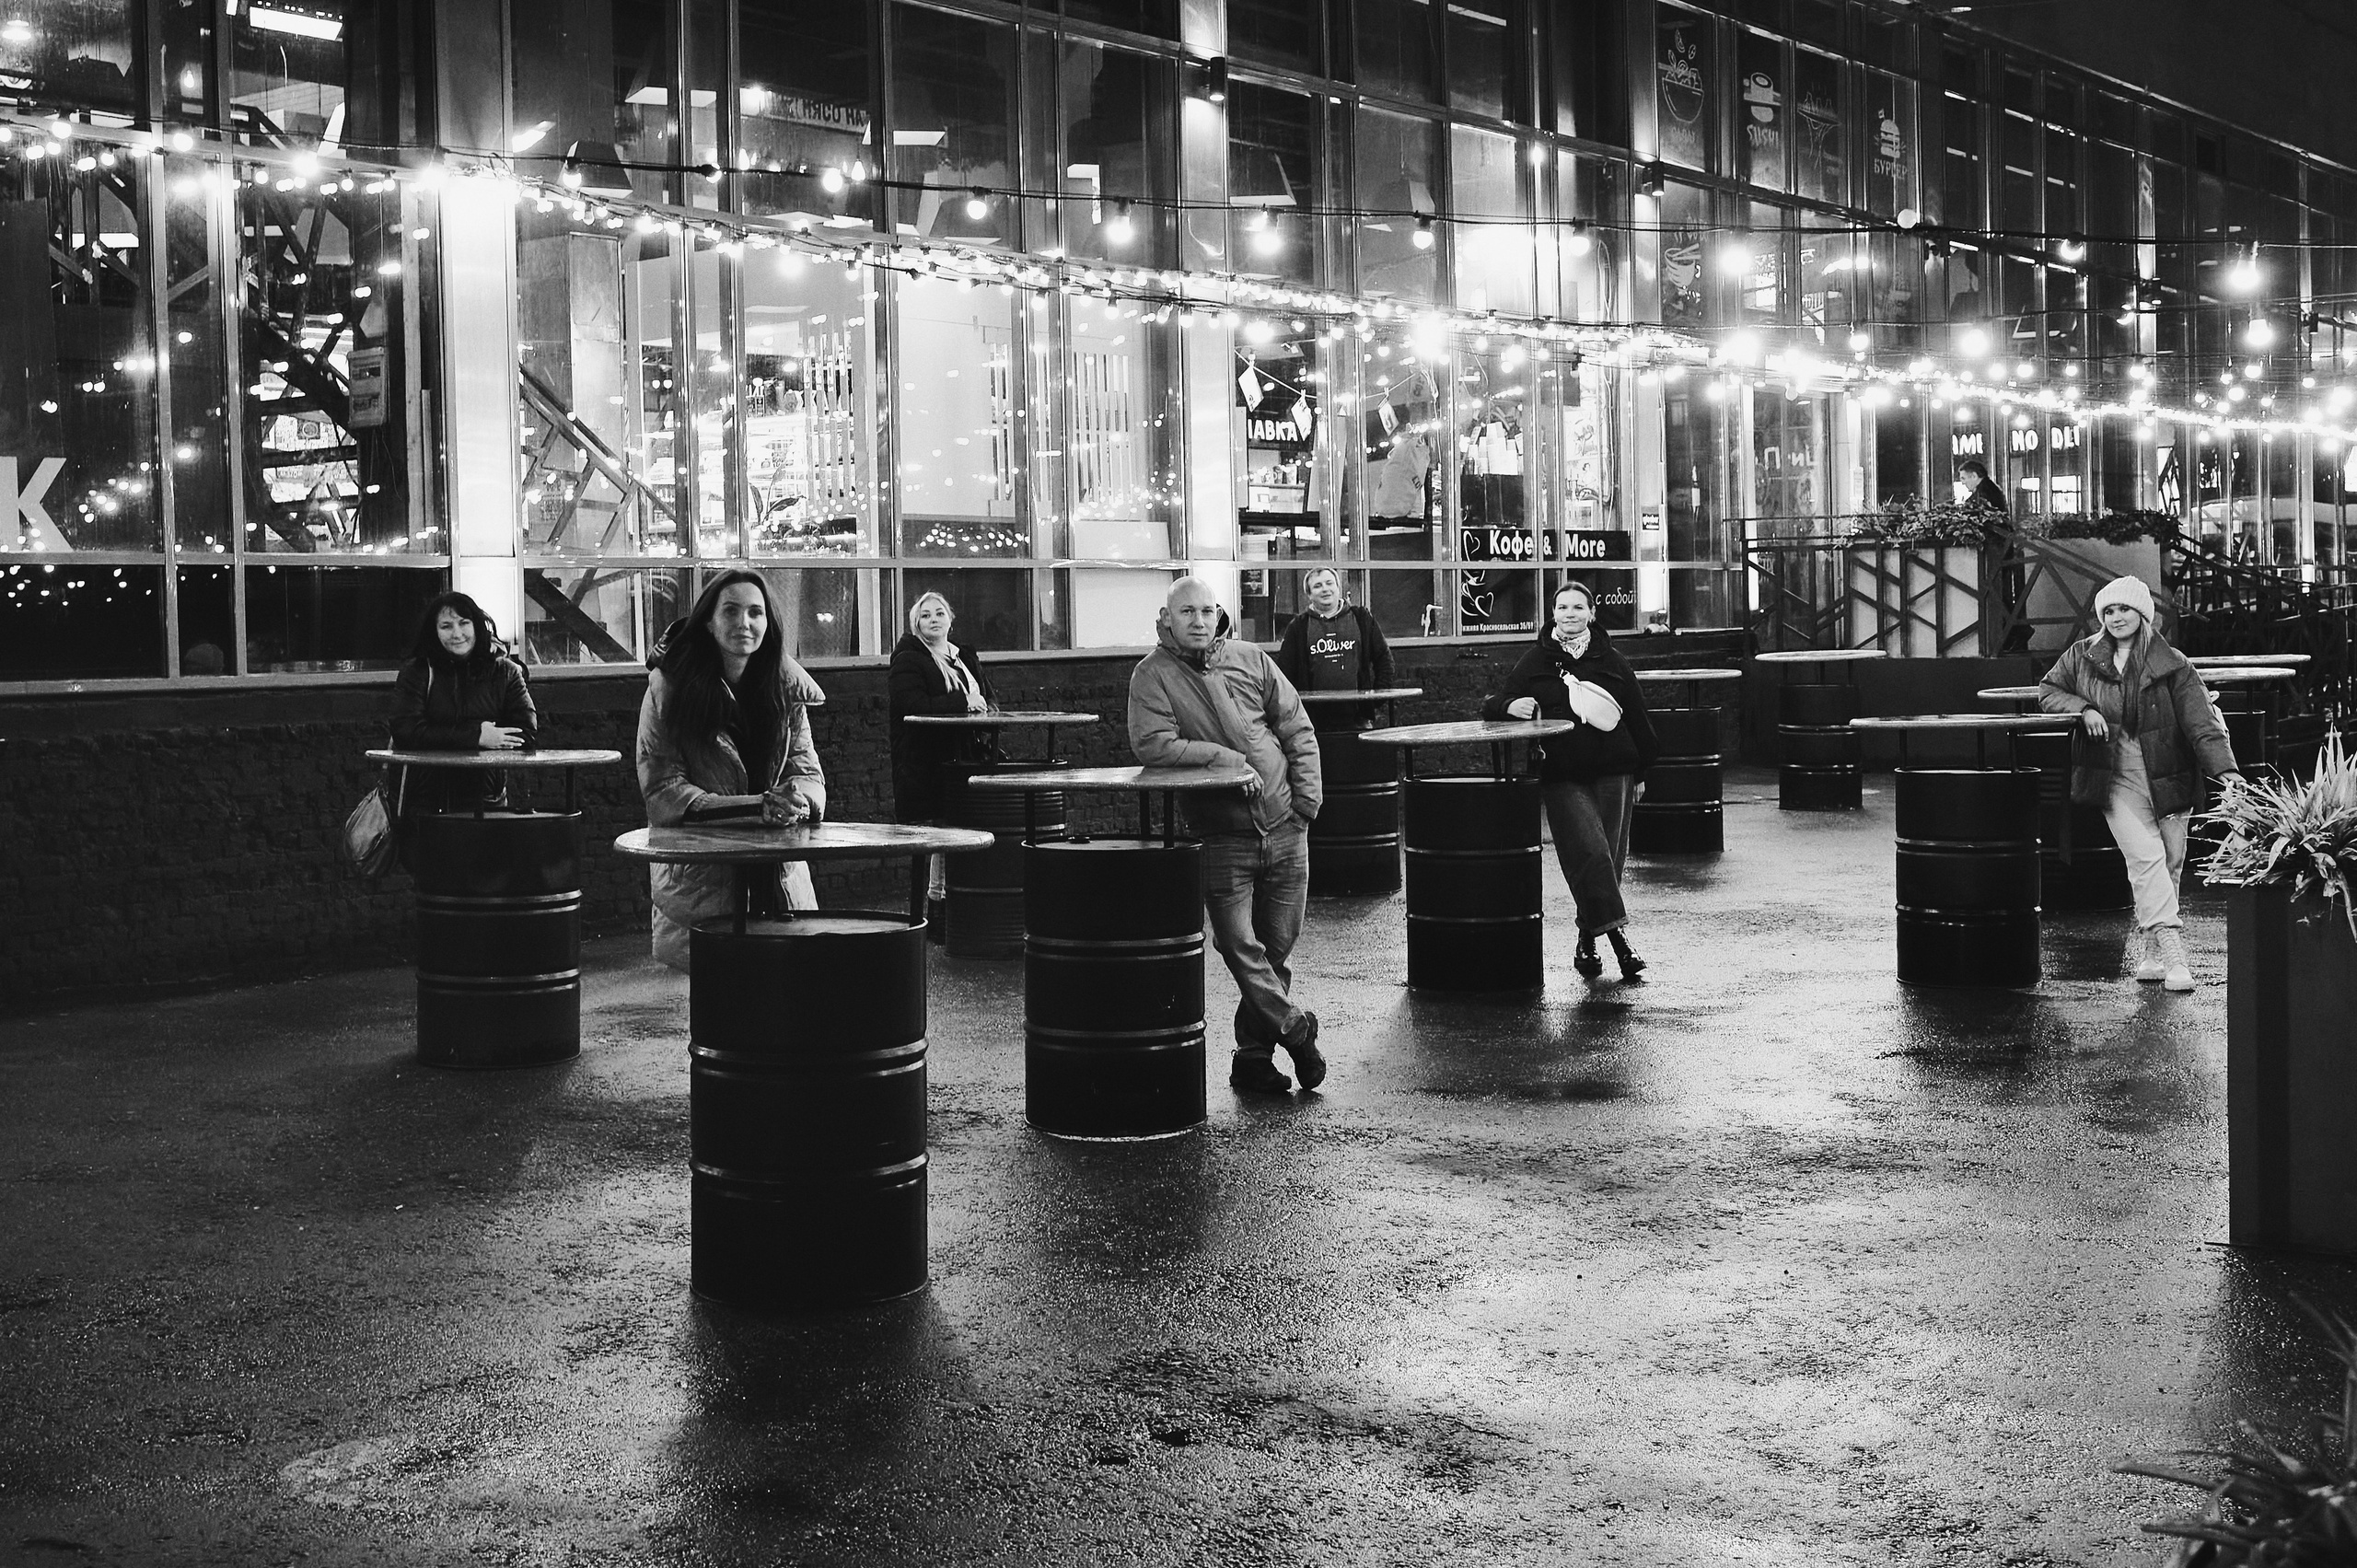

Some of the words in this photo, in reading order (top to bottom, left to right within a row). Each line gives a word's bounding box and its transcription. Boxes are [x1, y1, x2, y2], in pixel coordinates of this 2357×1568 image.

[1747, 123, 1779, 149] SUSHI
[1490, 529, 1534, 561] Кофе
[1543, 535, 1553, 555] &
[1565, 533, 1606, 558] More
[1595, 593, 1602, 606] с
[1605, 587, 1634, 606] собой
[1310, 638, 1355, 655] s.Oliver
